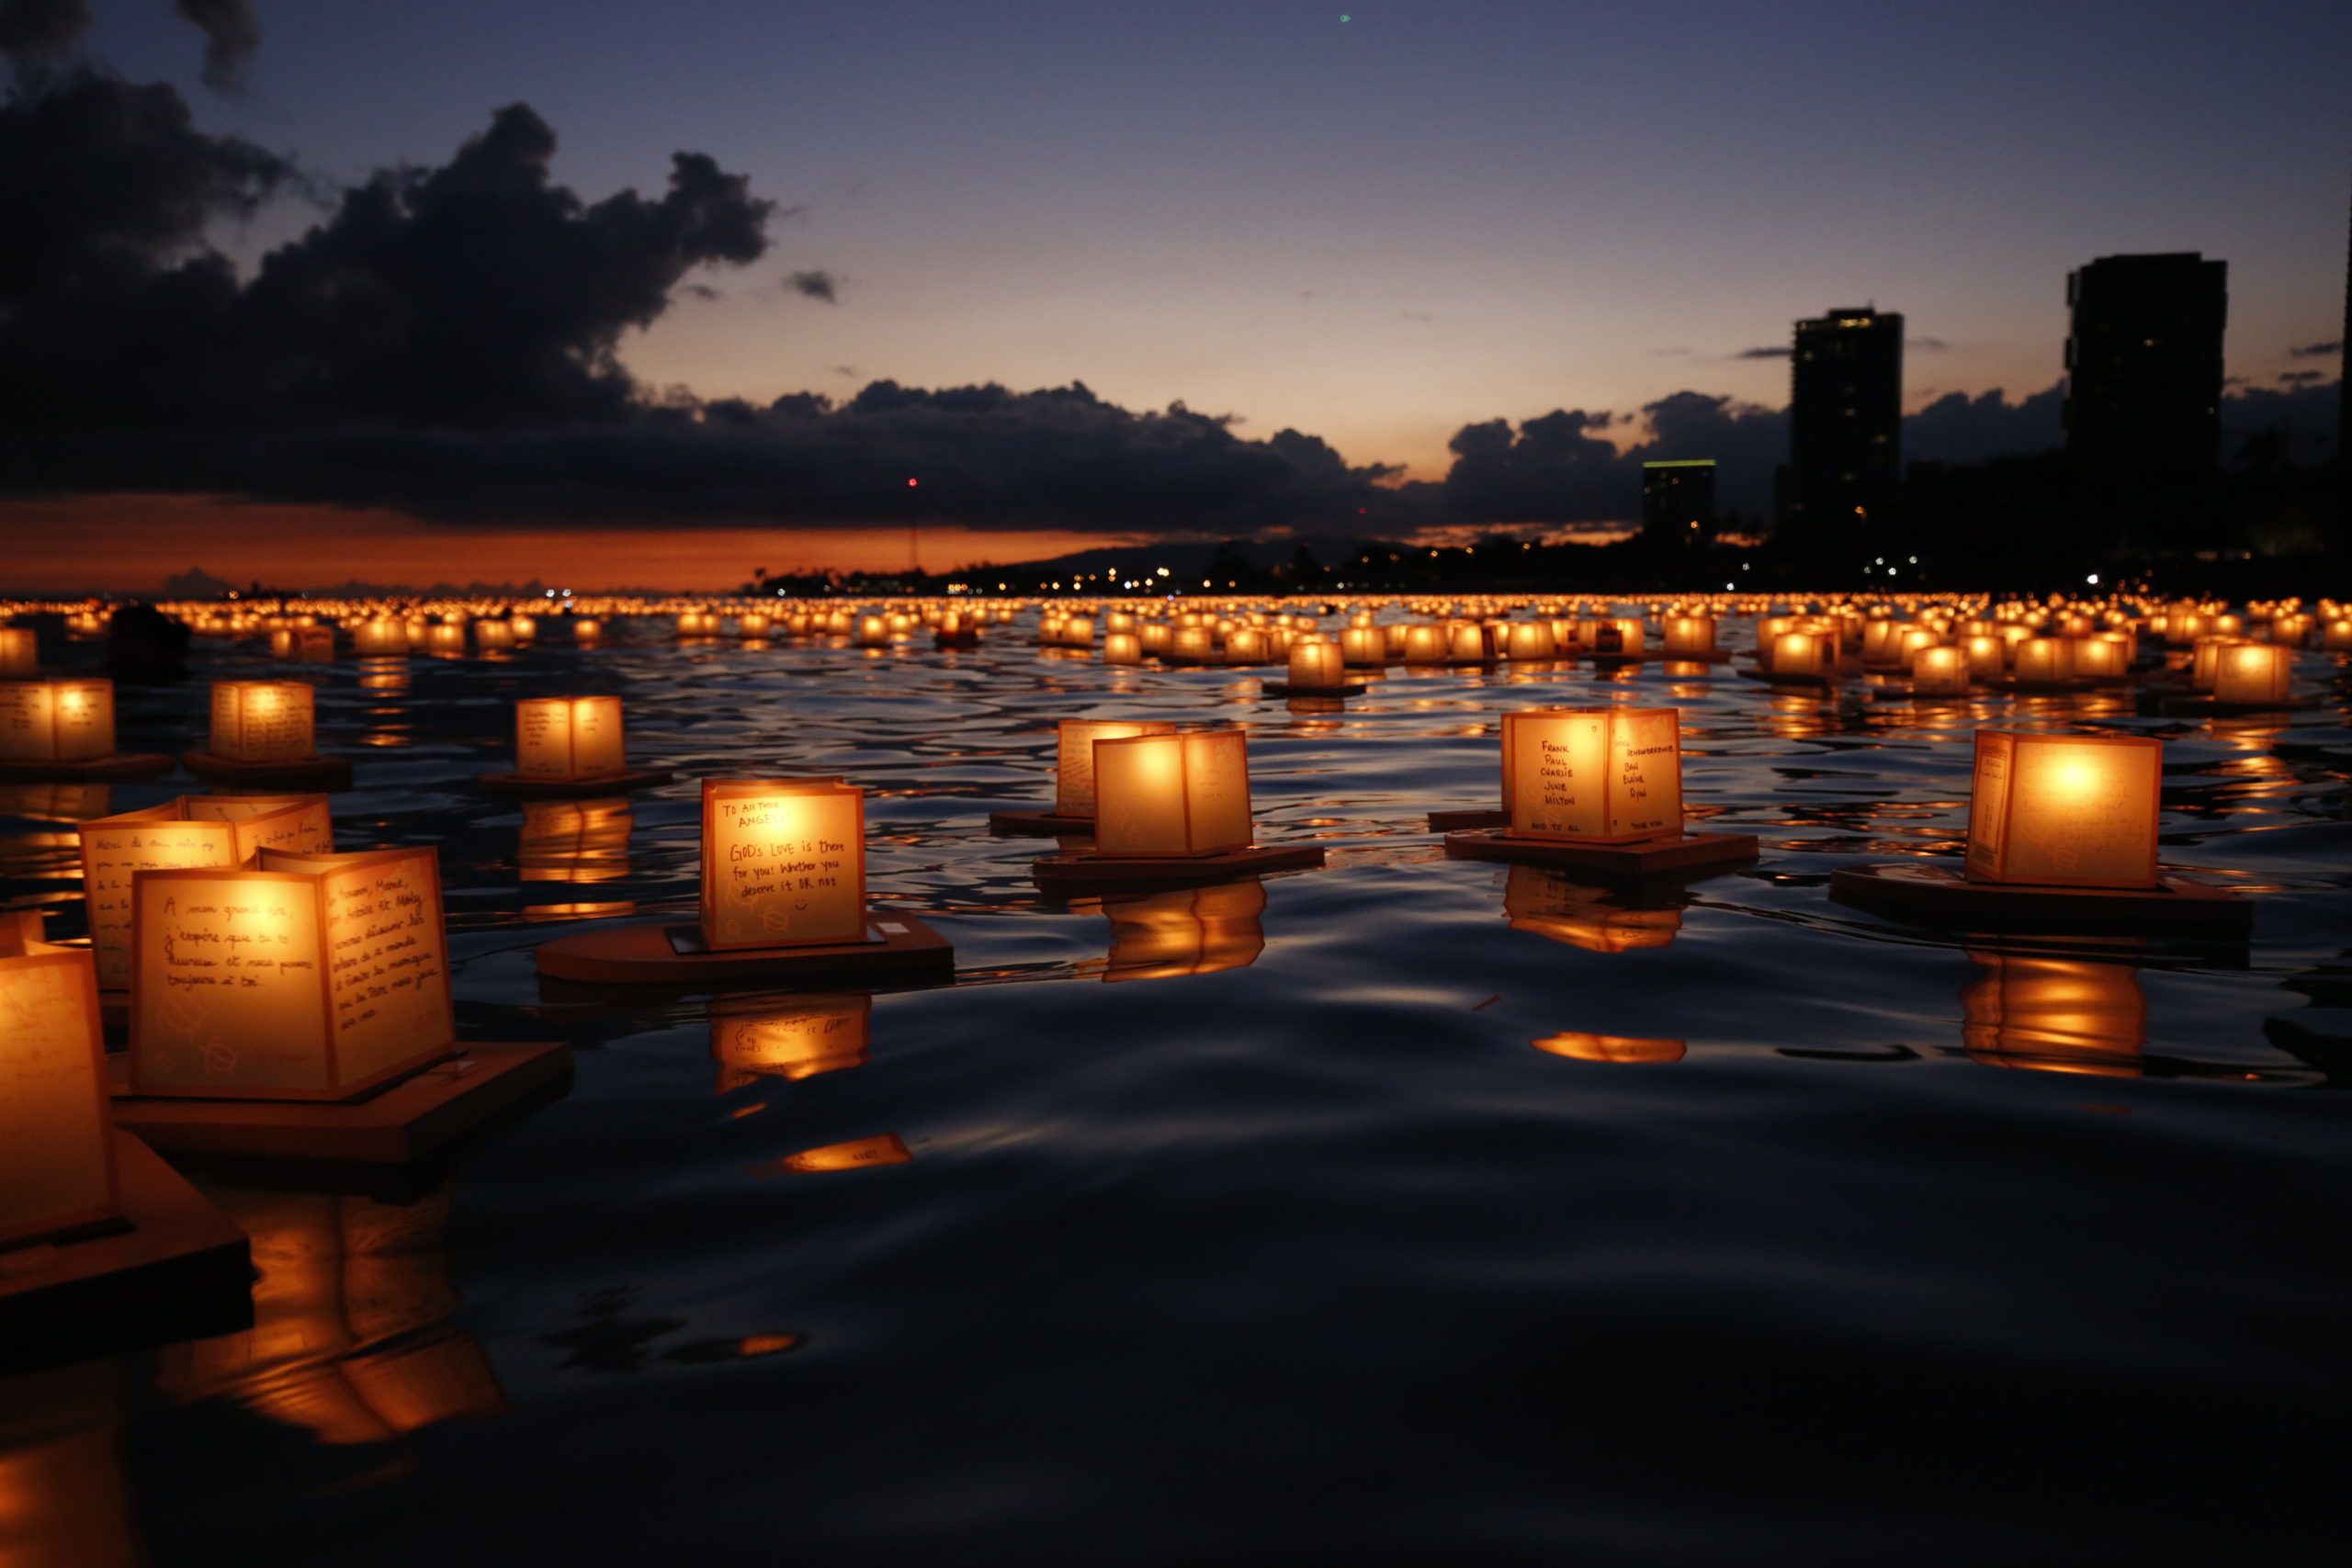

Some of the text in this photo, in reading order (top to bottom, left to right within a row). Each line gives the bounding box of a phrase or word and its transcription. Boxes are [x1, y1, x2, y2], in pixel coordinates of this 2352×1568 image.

[1542, 740, 1569, 752] FRANK
[1544, 754, 1567, 765] PAUL
[1544, 781, 1567, 792] JUNE
[1544, 793, 1576, 805] MILTON
[770, 843, 795, 858] LOVE
[802, 840, 811, 852] is
[819, 840, 845, 854] there
[732, 864, 748, 881] for
[821, 860, 840, 874] you
[741, 884, 775, 898] deserve
[781, 880, 792, 892] it
[818, 876, 837, 888] not
[186, 906, 219, 915] mon
[223, 933, 253, 951] que
[226, 956, 241, 967] et
